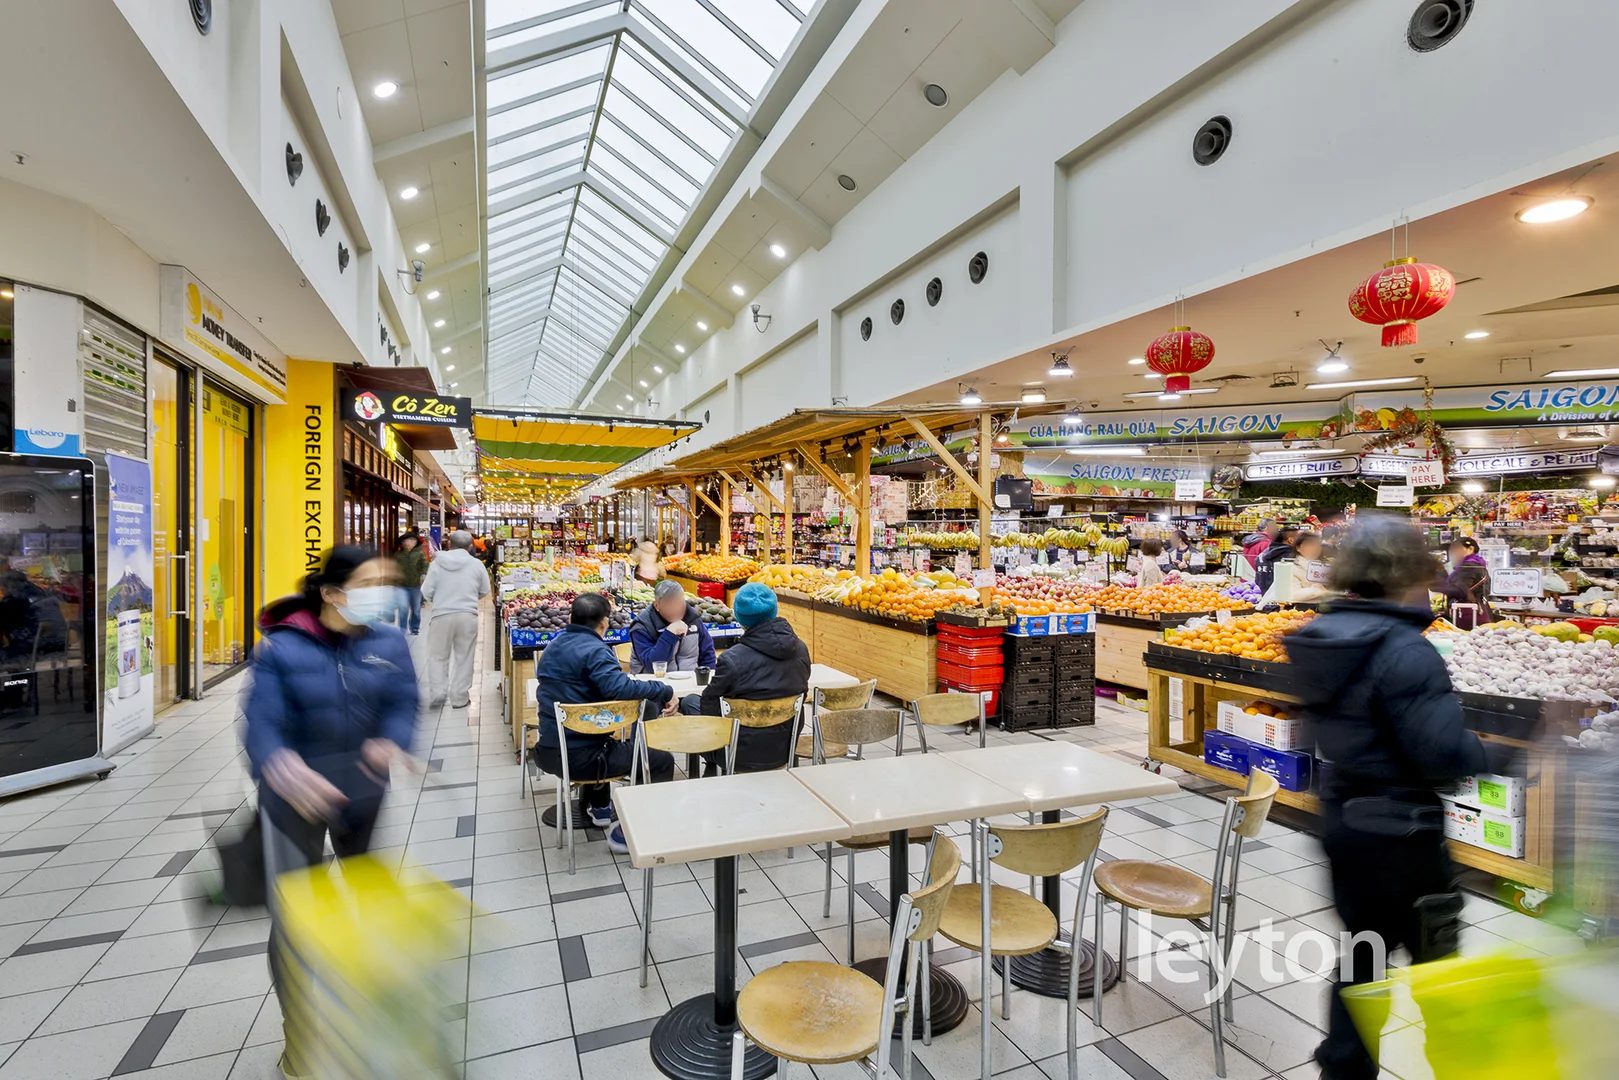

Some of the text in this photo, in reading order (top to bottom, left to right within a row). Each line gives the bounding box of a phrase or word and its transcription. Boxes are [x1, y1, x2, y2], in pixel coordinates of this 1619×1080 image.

[202, 313, 224, 342] MONEY
[225, 330, 252, 362] TRANSFER
[392, 395, 458, 418] Cô Zen
[392, 413, 432, 422] VIETNAMESE
[1537, 412, 1547, 421] A
[1550, 411, 1596, 421] Division
[1599, 409, 1612, 421] of
[1097, 422, 1124, 436] RAU
[1169, 413, 1283, 436] SAIGON
[29, 428, 65, 438] Lebara
[1544, 452, 1598, 466] RETAIL
[1070, 463, 1191, 482] SAIGON FRESH
[1259, 460, 1342, 475] FRESH FRUITS
[1411, 464, 1431, 473] PAY
[1411, 474, 1437, 484] HERE
[305, 404, 321, 578] FOREIGN EXCHAN
